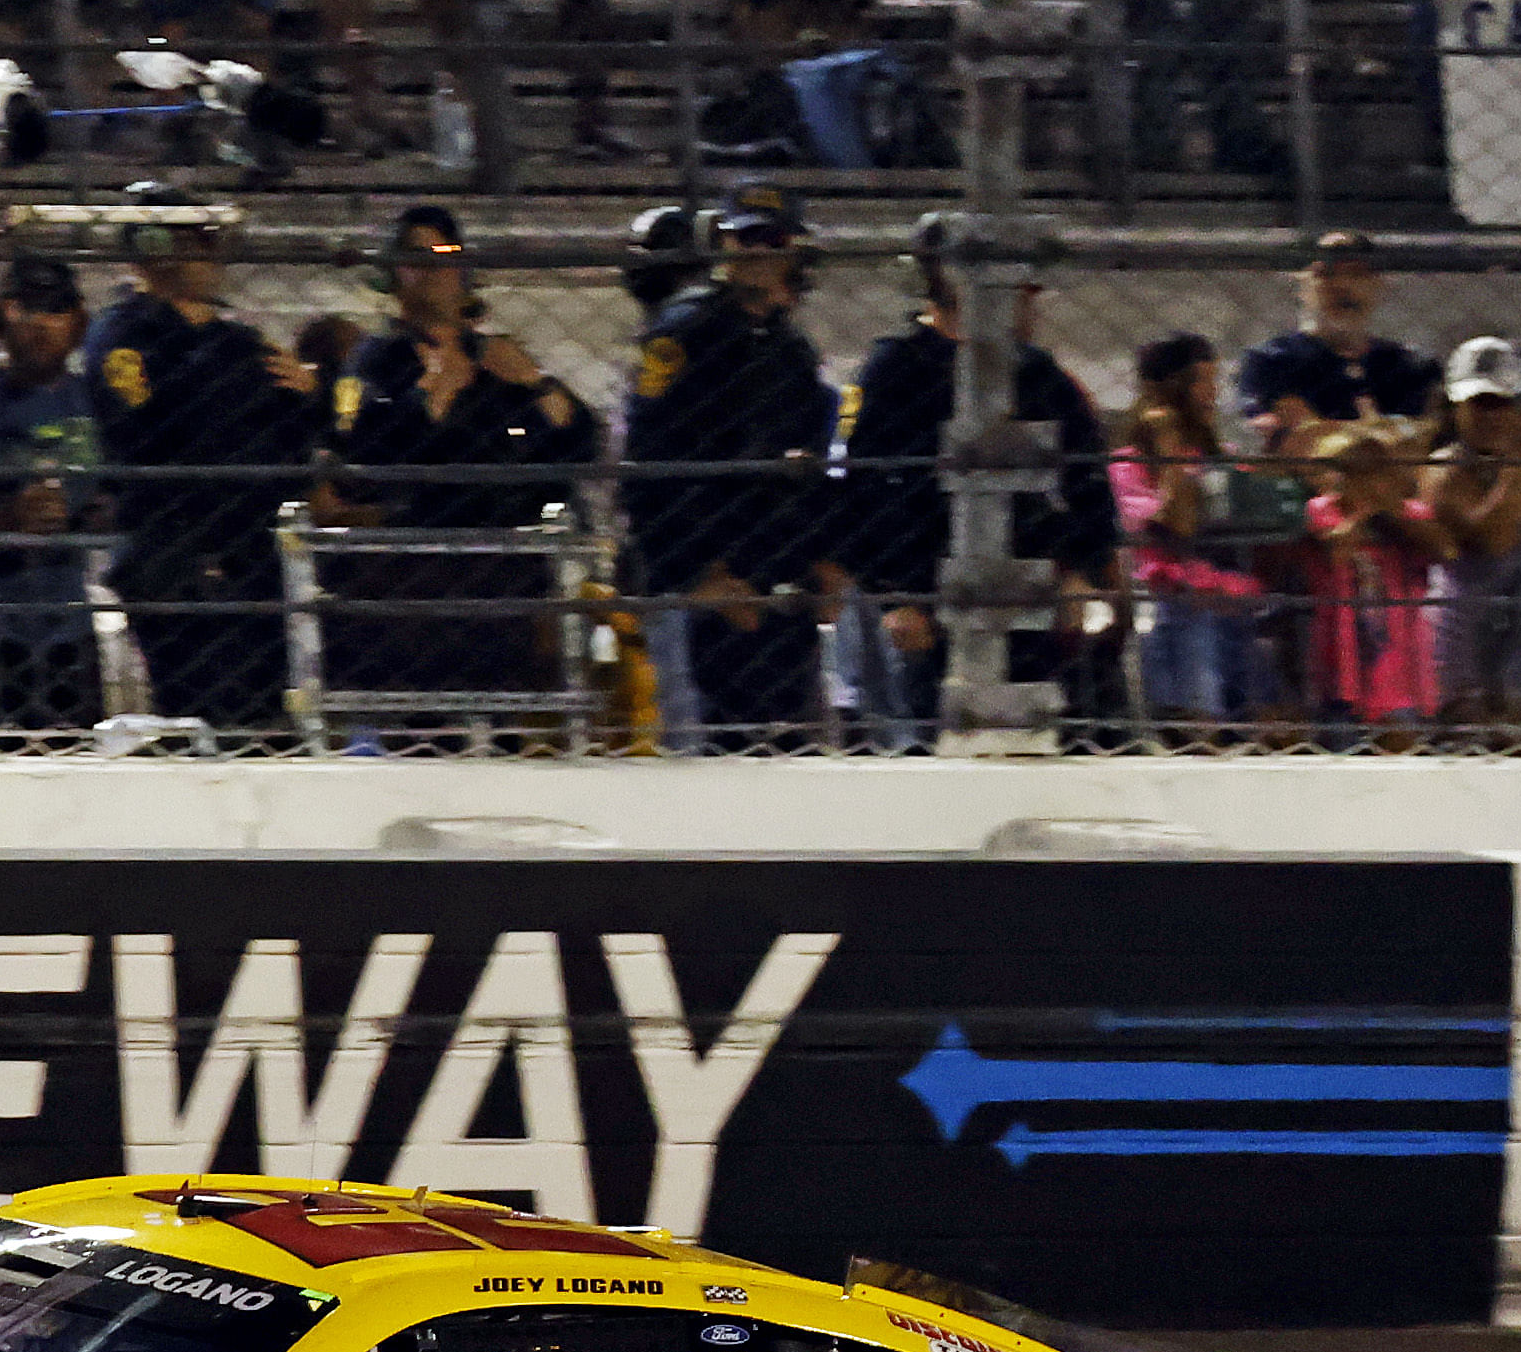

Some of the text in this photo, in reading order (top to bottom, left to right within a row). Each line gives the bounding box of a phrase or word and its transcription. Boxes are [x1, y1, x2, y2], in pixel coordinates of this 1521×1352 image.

[105, 1259, 275, 1312] LOGANO
[473, 1276, 664, 1296] JOEY LOGANO
